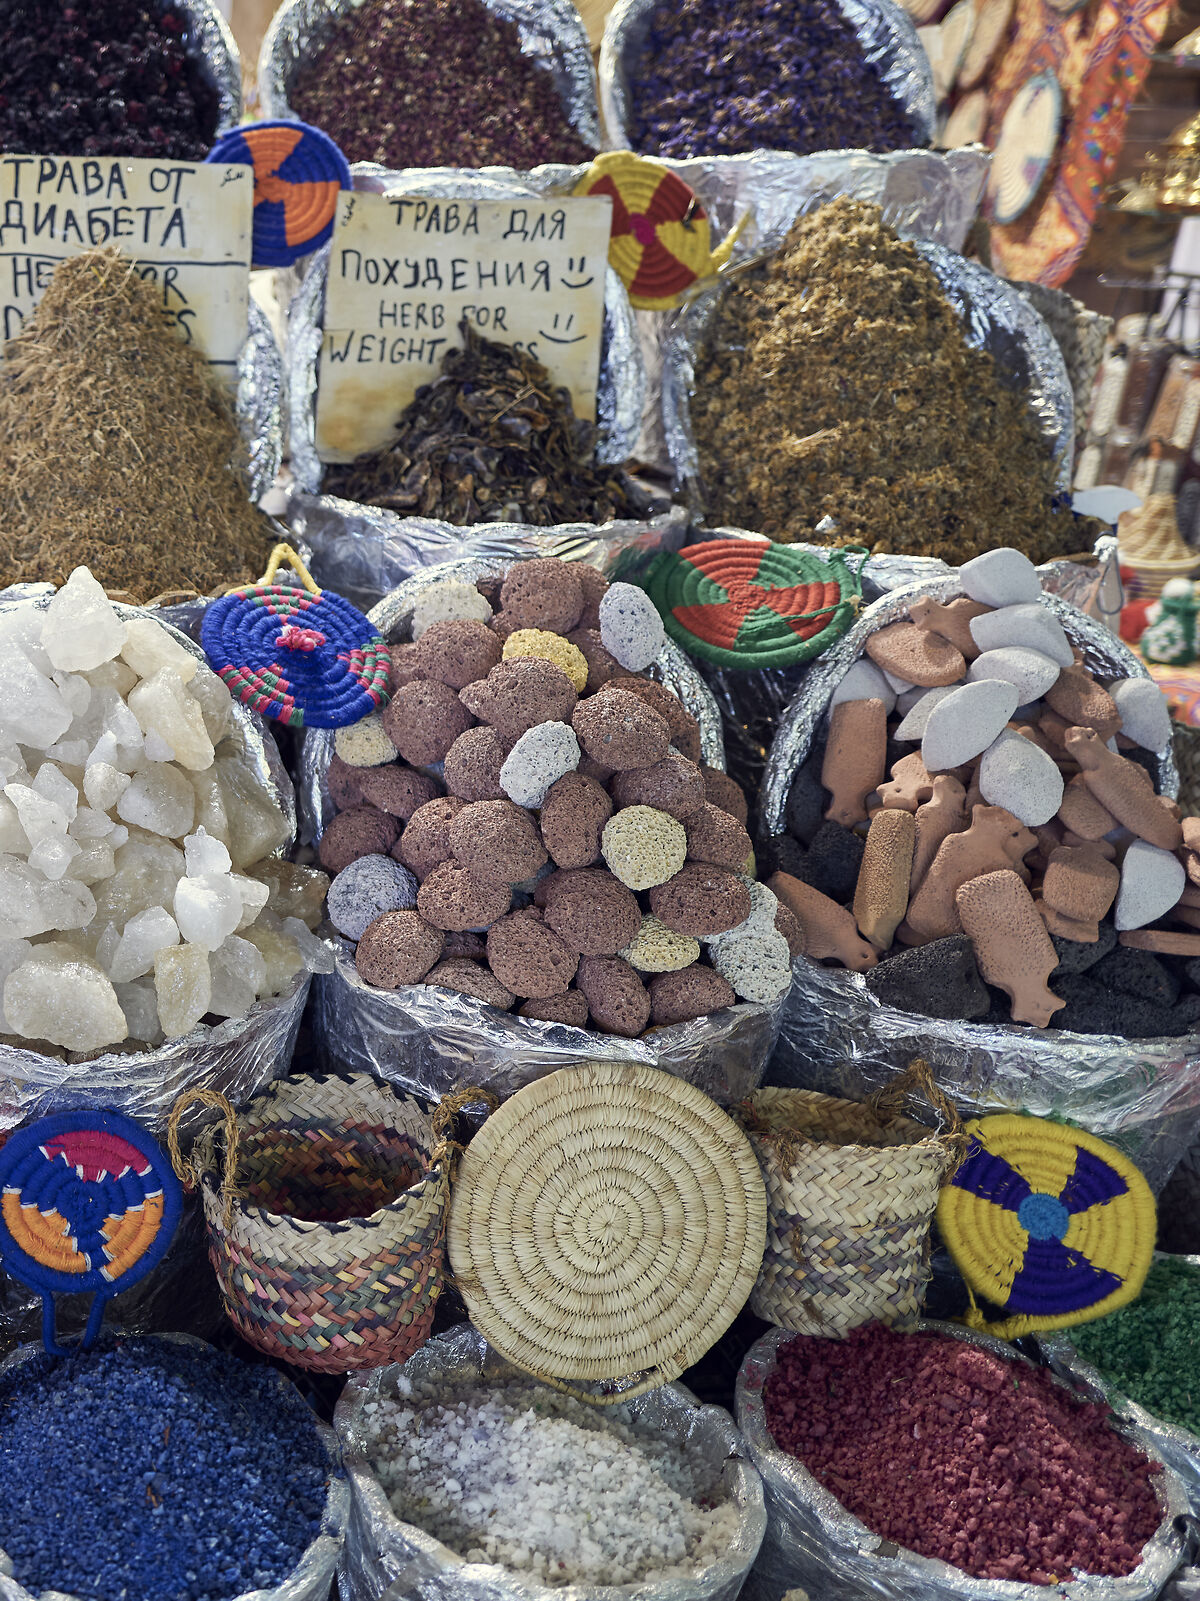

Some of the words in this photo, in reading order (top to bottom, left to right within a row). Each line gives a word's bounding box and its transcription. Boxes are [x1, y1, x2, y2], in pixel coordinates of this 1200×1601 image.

[3, 158, 127, 199] ТРАВА
[150, 167, 196, 204] ОТ
[0, 200, 185, 248] ДИАБЕТА
[389, 200, 479, 235] ТРАВА
[503, 209, 566, 241] ДЛЯ
[341, 250, 550, 292] ПОХУДЕНИЯ
[379, 300, 445, 330] HERB
[330, 330, 447, 364] WEIGHT
